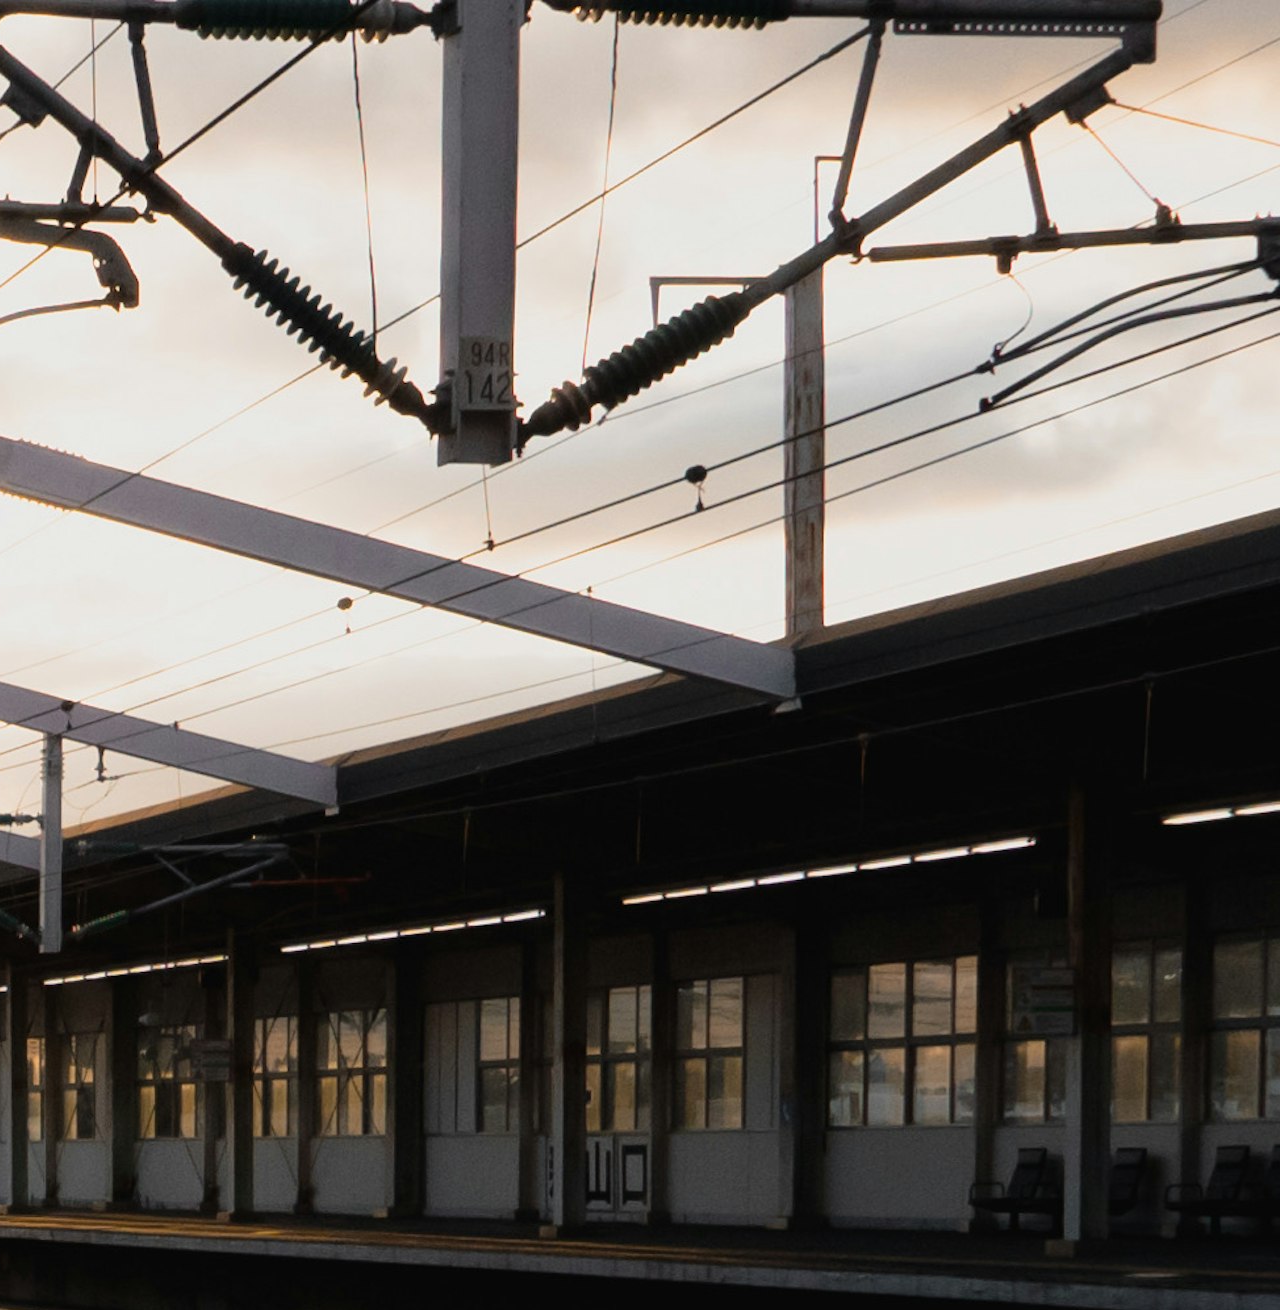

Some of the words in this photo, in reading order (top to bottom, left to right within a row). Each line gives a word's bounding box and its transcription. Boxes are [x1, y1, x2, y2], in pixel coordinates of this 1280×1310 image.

[471, 341, 510, 367] 94R
[465, 370, 511, 404] 142
[549, 1140, 648, 1206] 山口
